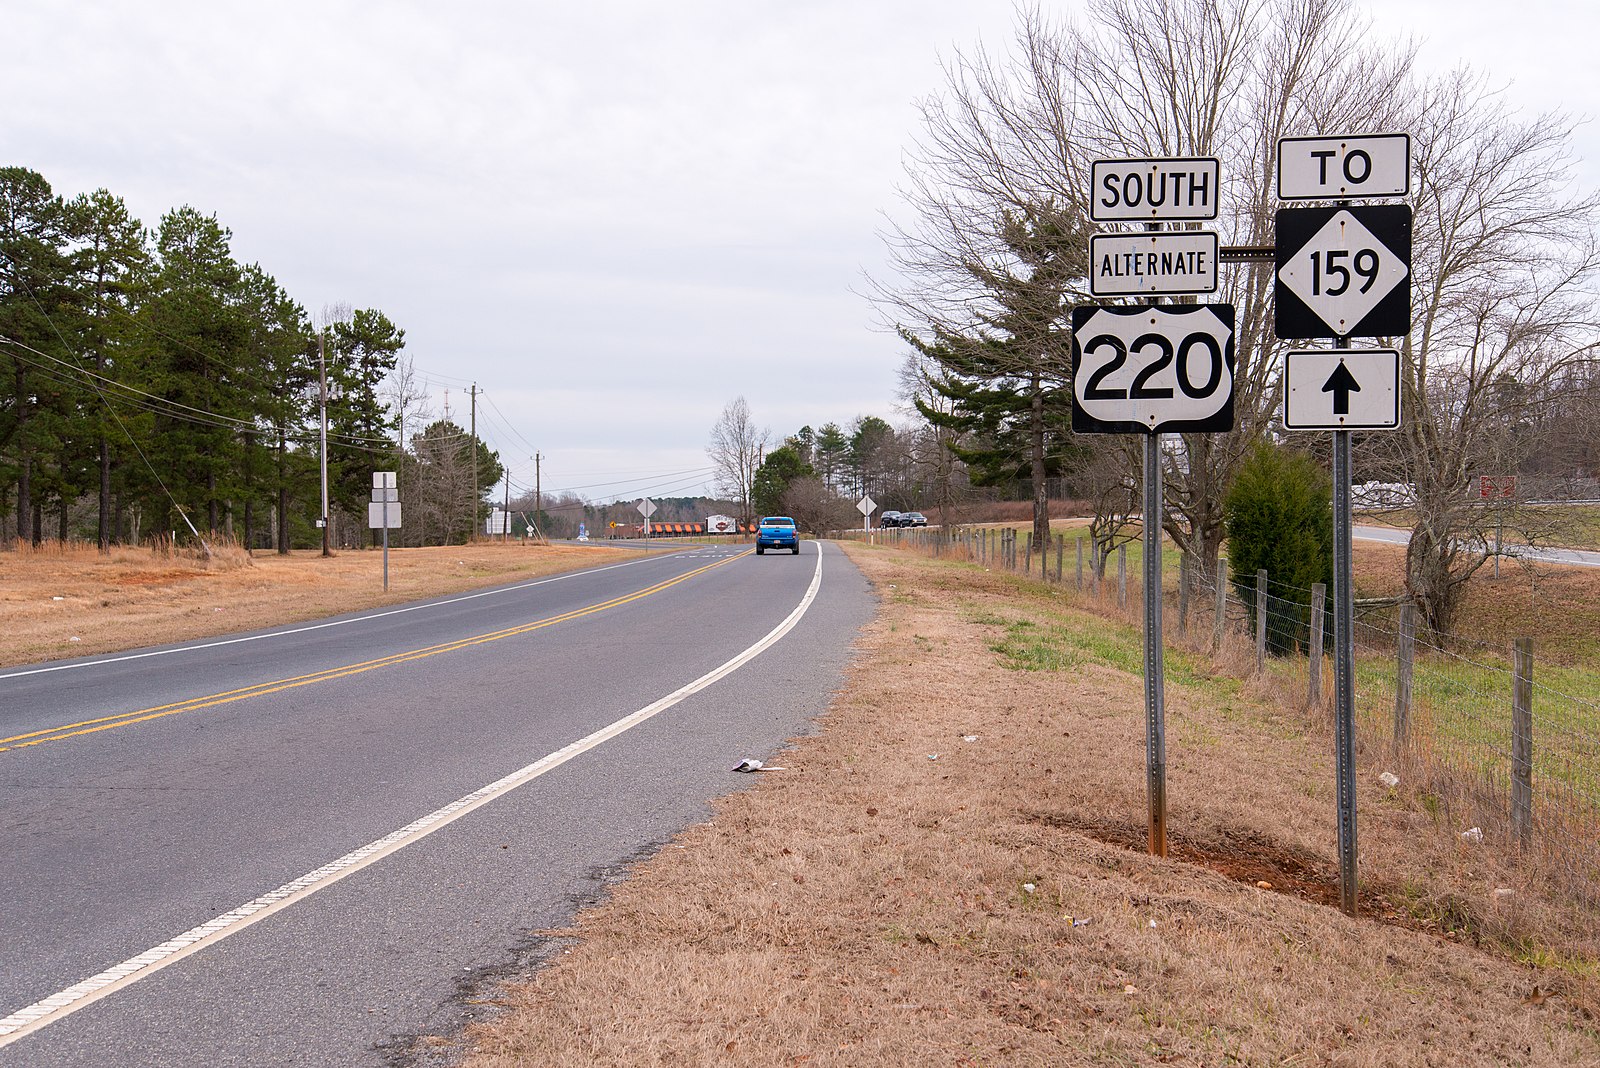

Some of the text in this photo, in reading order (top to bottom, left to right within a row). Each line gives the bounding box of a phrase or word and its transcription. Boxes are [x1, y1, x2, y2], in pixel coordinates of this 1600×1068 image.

[1310, 150, 1372, 186] TO
[1102, 172, 1209, 209] SOUTH
[1100, 252, 1207, 277] ALTERNATE
[1310, 248, 1380, 297] 159
[1083, 331, 1223, 401] 220
